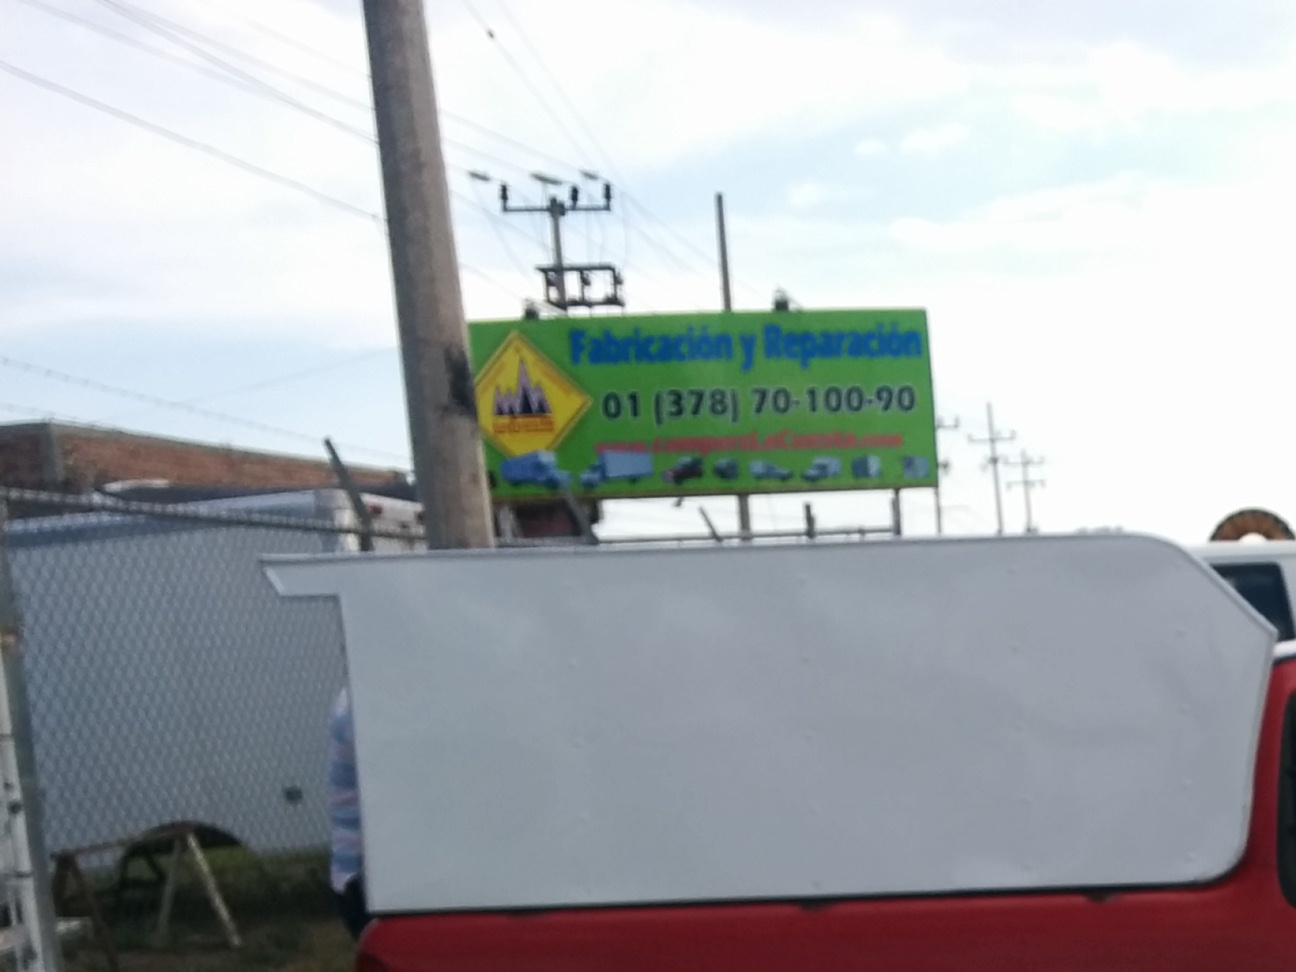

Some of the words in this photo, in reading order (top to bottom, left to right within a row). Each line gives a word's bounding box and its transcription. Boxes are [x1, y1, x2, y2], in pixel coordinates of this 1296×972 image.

[571, 326, 733, 365] Fabricación
[740, 334, 756, 372] y
[763, 323, 922, 369] Reparación
[602, 390, 640, 419] 01
[654, 387, 738, 426] (378)
[751, 385, 915, 414] 70-100-90
